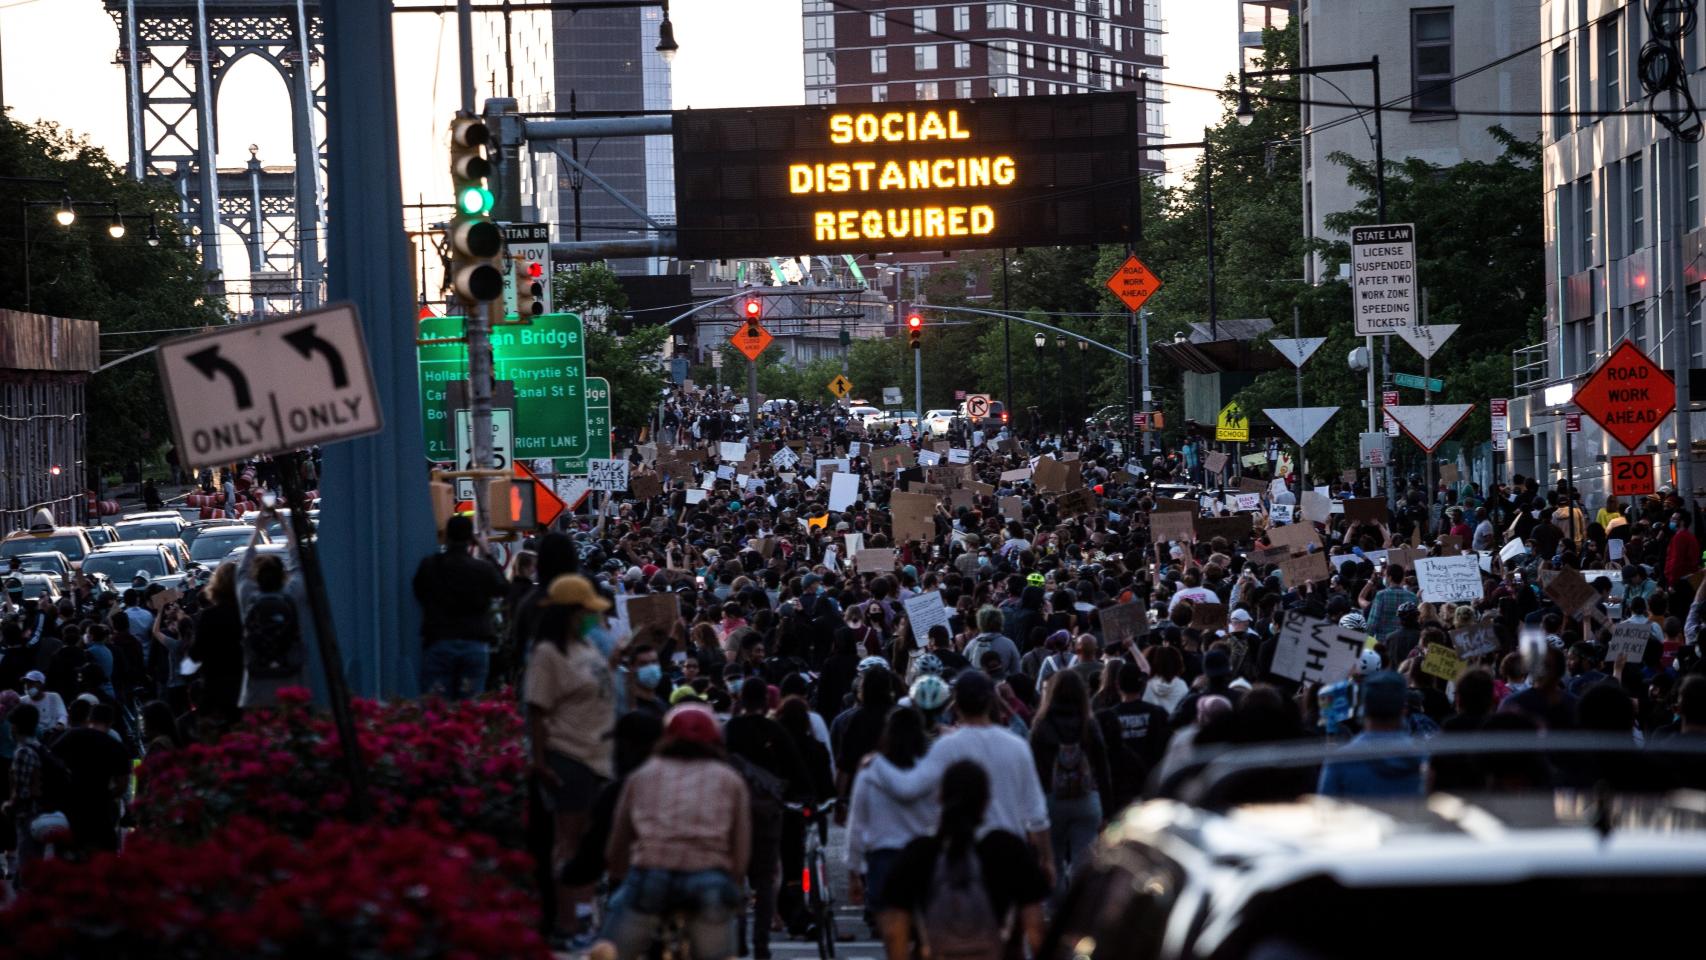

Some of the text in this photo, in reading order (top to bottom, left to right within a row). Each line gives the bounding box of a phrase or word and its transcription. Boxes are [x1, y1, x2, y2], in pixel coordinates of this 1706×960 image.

[829, 110, 970, 144] SOCIAL
[788, 155, 1016, 194] DISTANCING
[814, 205, 995, 241] REQUIRED
[534, 228, 548, 238] BR
[1356, 229, 1409, 242] STATE LAW
[1363, 246, 1404, 257] LICENSE
[1123, 266, 1144, 274] ROAD
[1356, 260, 1412, 272] SUSPENDED
[1123, 278, 1145, 286] WORK
[1358, 274, 1411, 286] AFTER TWO
[1122, 289, 1147, 297] AHEAD
[1361, 288, 1409, 300] WORK ZONE
[1362, 303, 1410, 314] SPEEDING
[1367, 317, 1407, 328] TICKETS
[521, 330, 578, 348] Bridge
[510, 366, 578, 380] Chrystie St
[1607, 366, 1649, 381] ROAD
[551, 386, 564, 397] St
[569, 385, 576, 395] E
[1608, 388, 1650, 403] WORK
[1605, 409, 1657, 425] AHEAD
[192, 395, 363, 454] ONLY ONLY
[1219, 430, 1246, 438] SCHOOL
[515, 436, 578, 448] RIGHT LANE
[592, 461, 625, 471] BLACK
[1617, 461, 1649, 480] 20
[590, 471, 624, 480] LIVES
[588, 479, 627, 490] MATTER
